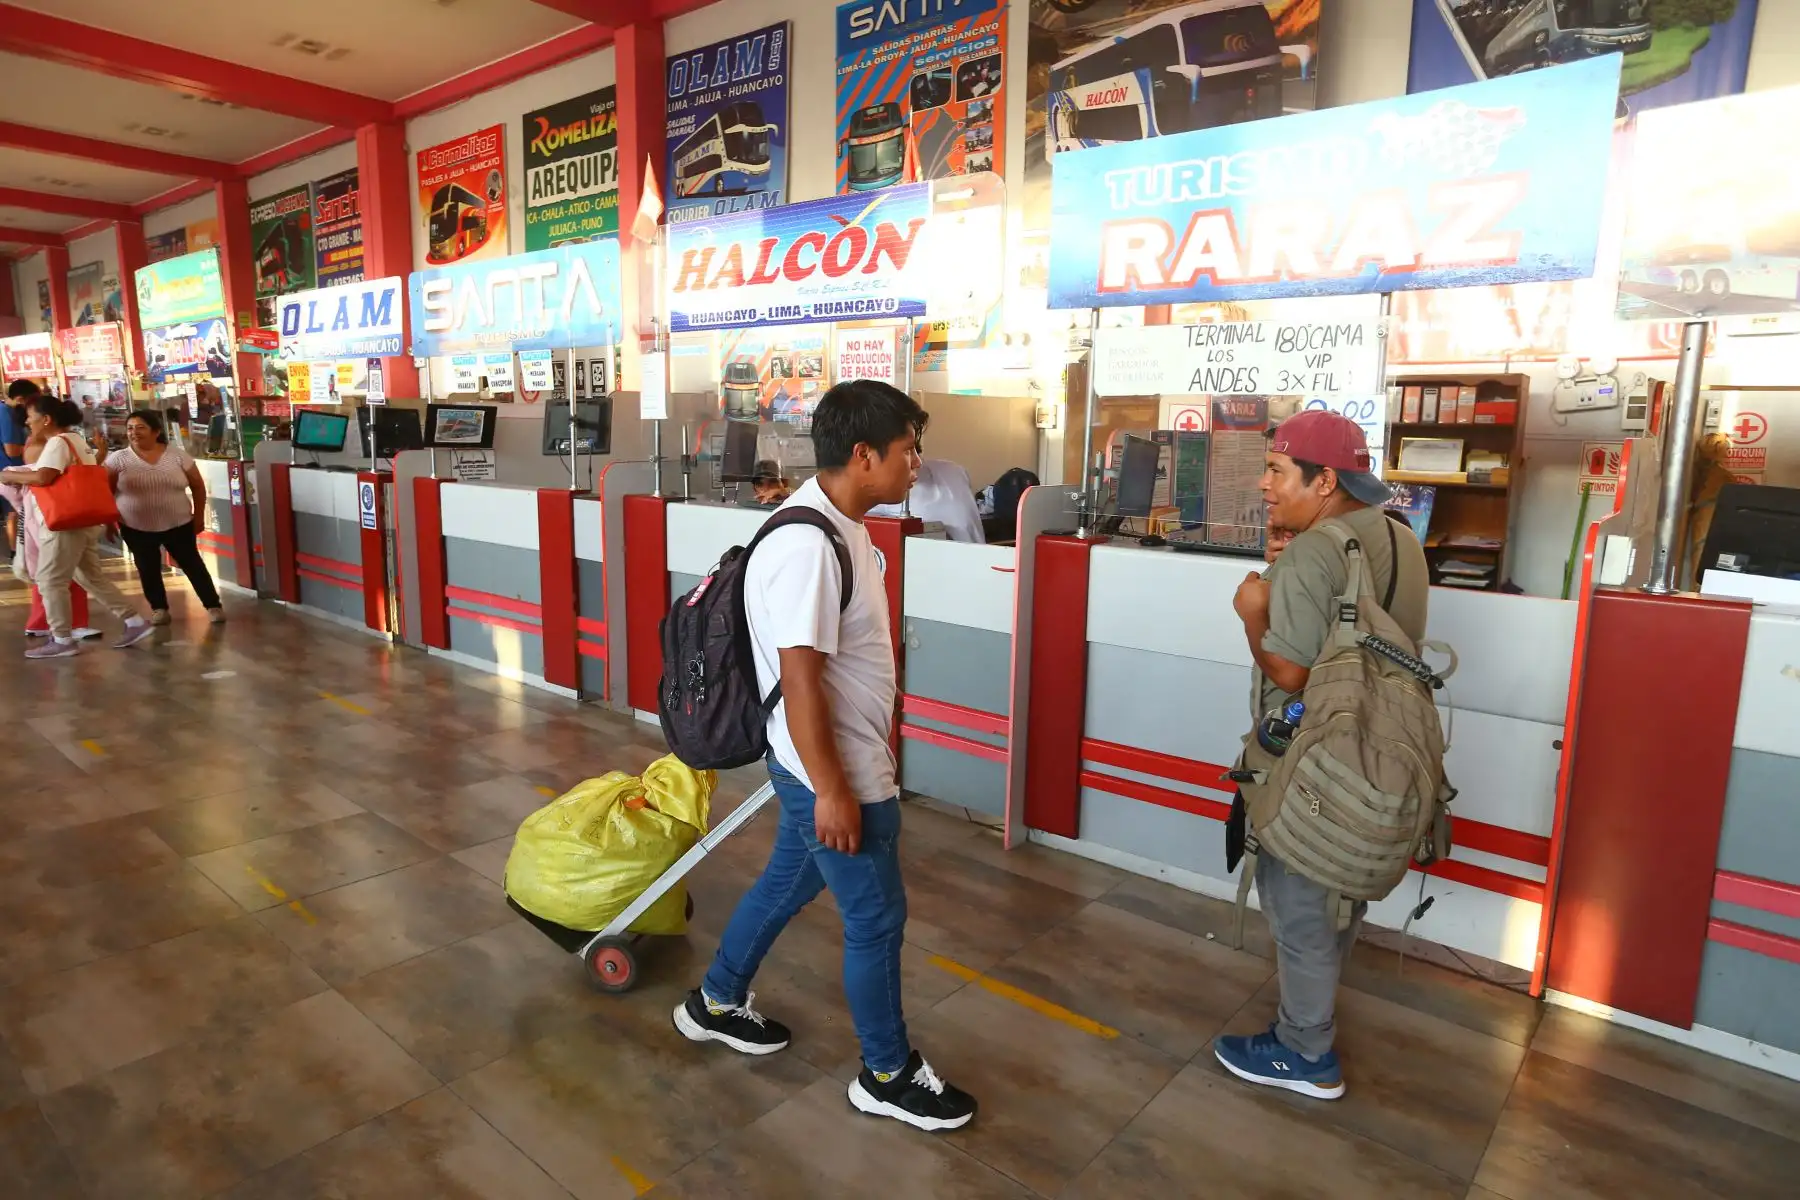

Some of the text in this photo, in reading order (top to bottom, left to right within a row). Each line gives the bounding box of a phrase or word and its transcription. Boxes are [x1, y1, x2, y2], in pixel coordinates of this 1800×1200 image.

[943, 22, 999, 45] HUANCAYO
[769, 30, 783, 70] BUS
[872, 37, 911, 55] SALIDAS
[668, 34, 766, 98] OLAM
[668, 75, 783, 113] LIMA JAUJA HUANCAYO
[1085, 86, 1128, 107] HALCON
[714, 190, 780, 216] OLAM
[581, 215, 603, 230] PUNO
[667, 205, 709, 224] COURIER
[1097, 170, 1531, 294] RARAZ
[282, 288, 395, 336] OLAM
[691, 307, 757, 324] HUANCAYO
[768, 303, 801, 319] LIMA
[813, 298, 895, 316] HUANCAYO
[846, 340, 885, 351] NO HAY
[1184, 323, 1265, 348] TERMINAL
[840, 353, 892, 366] DEVOLUCION
[1207, 349, 1332, 369] LOS VIP
[841, 365, 892, 379] DE PASAJE
[1188, 366, 1259, 393] ANDES
[1312, 370, 1352, 392] FIL
[1223, 401, 1257, 416] RARAZ
[1727, 447, 1765, 458] OTIQUIN
[1581, 481, 1616, 493] ETINTOR
